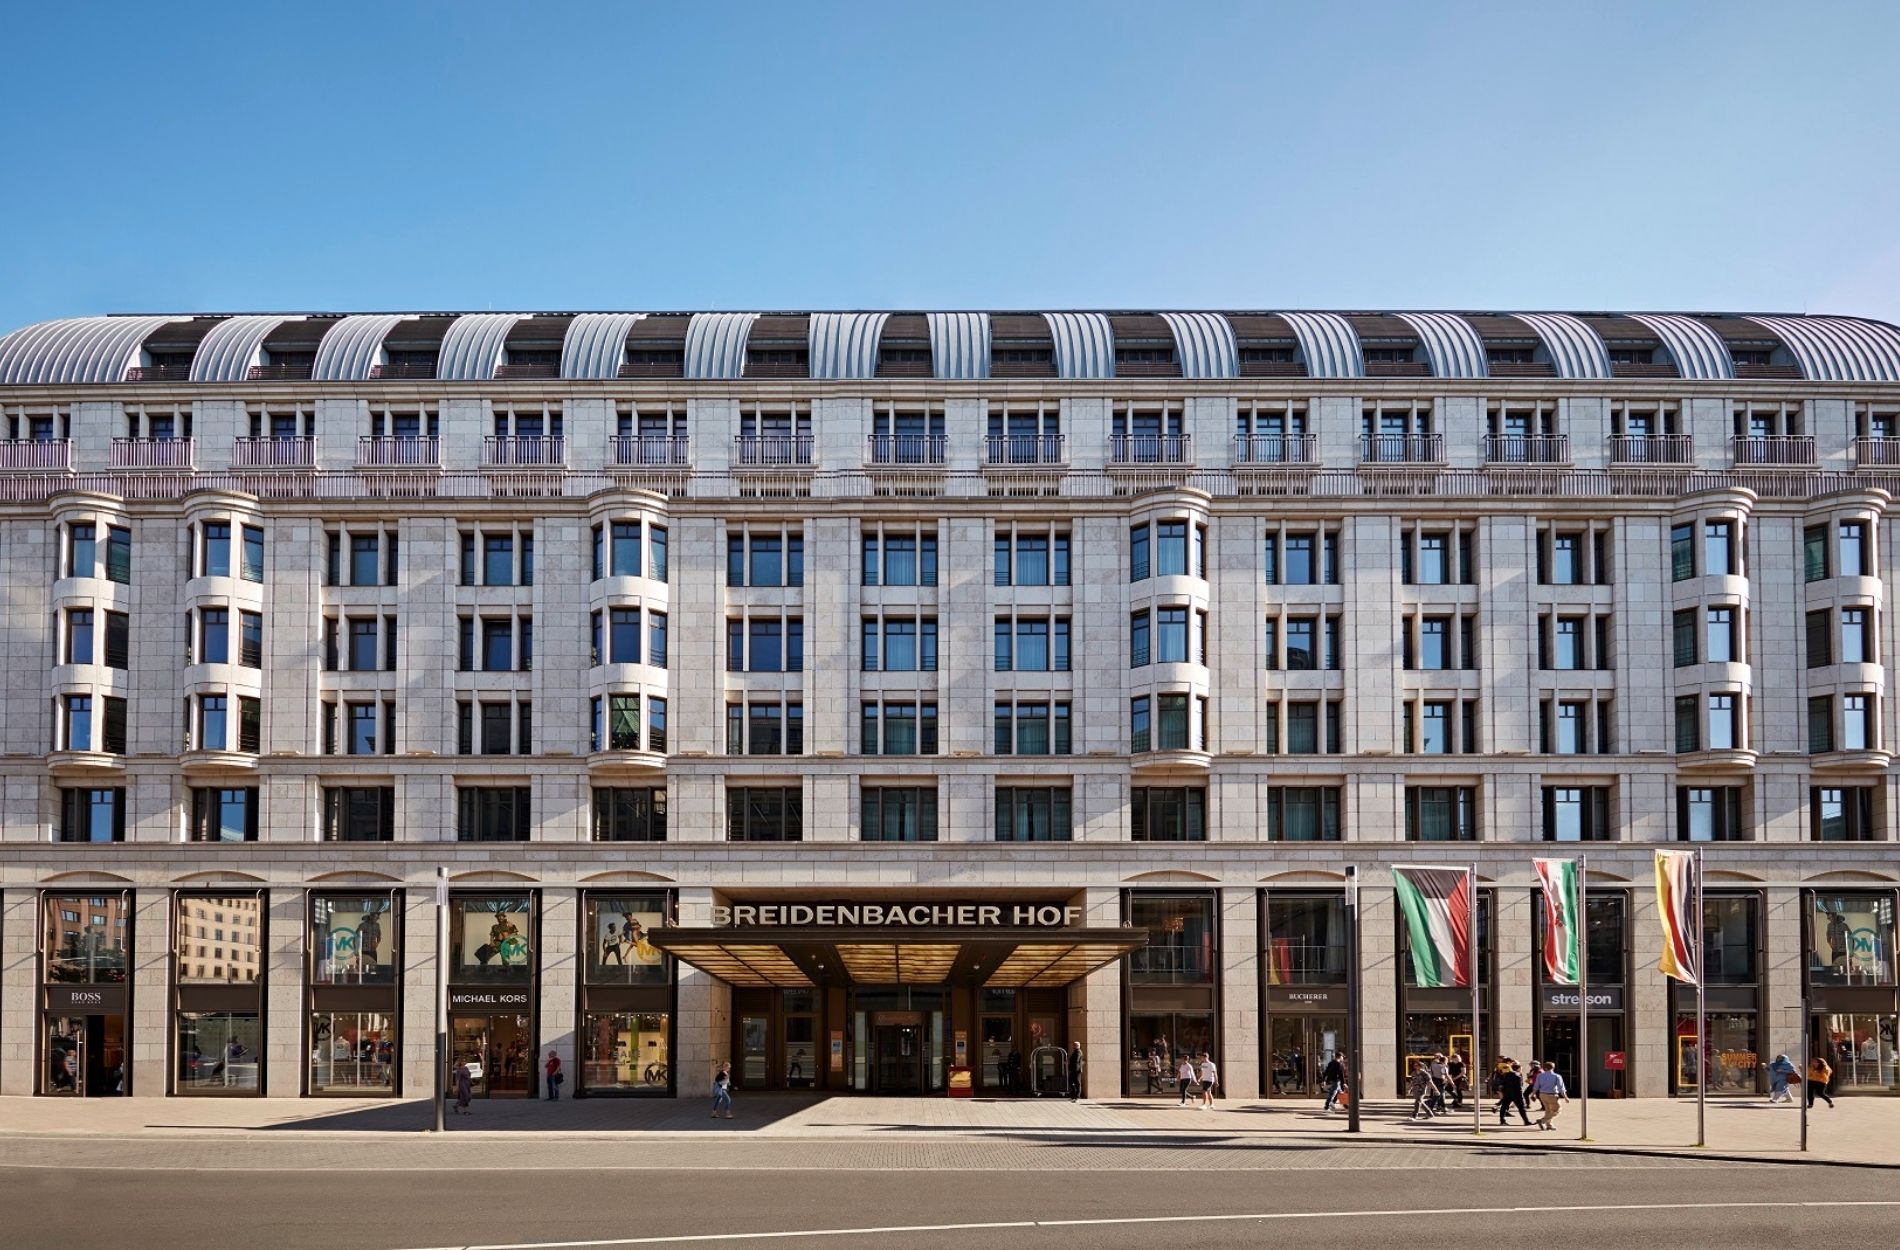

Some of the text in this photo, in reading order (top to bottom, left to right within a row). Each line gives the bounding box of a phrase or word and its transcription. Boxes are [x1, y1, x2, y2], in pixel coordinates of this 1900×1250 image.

[712, 905, 1082, 926] BREIDENBACHER HOF
[71, 992, 101, 1001] BOSS
[452, 994, 528, 1003] MICHAEL KORS
[1551, 993, 1612, 1005] streson
